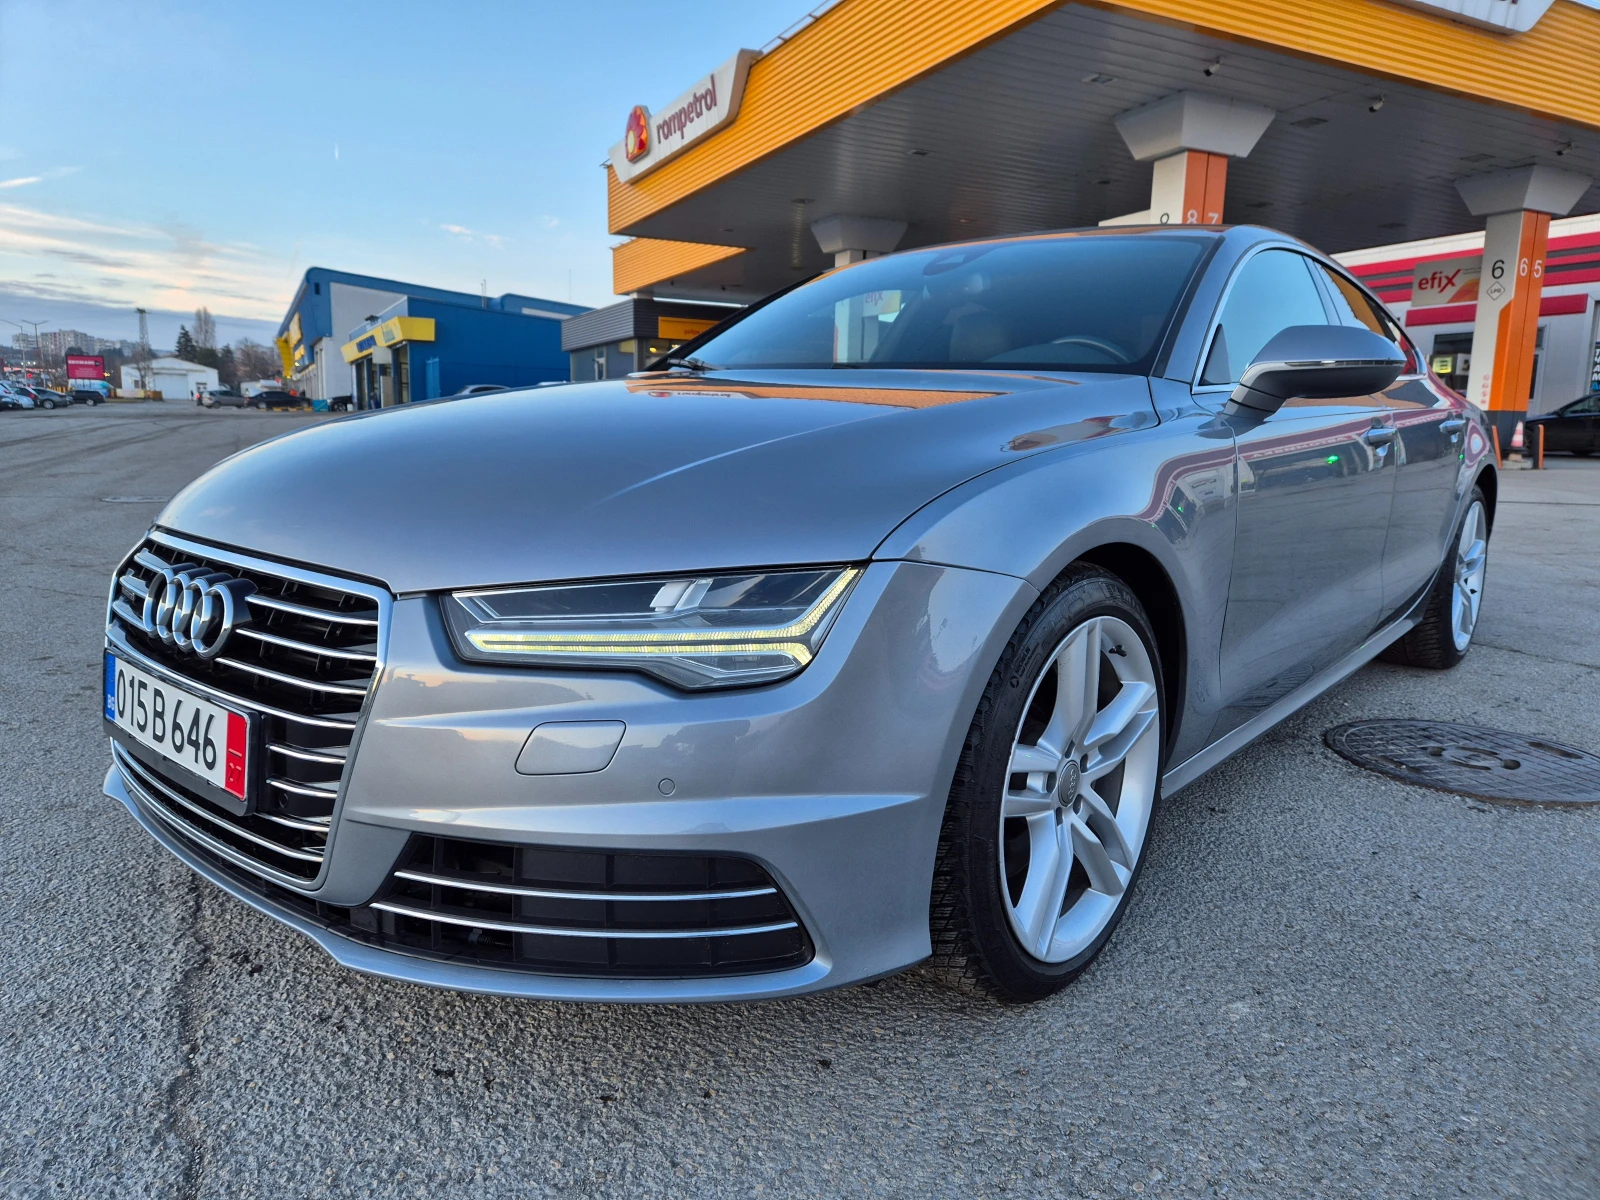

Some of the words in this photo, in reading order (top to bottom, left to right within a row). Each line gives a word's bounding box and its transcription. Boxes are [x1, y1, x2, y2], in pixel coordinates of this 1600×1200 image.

[656, 73, 718, 145] rompetrol
[1491, 259, 1505, 280] 6
[1519, 257, 1529, 277] 6
[1533, 259, 1543, 279] 5
[1418, 268, 1462, 294] efix
[107, 694, 115, 711] BG
